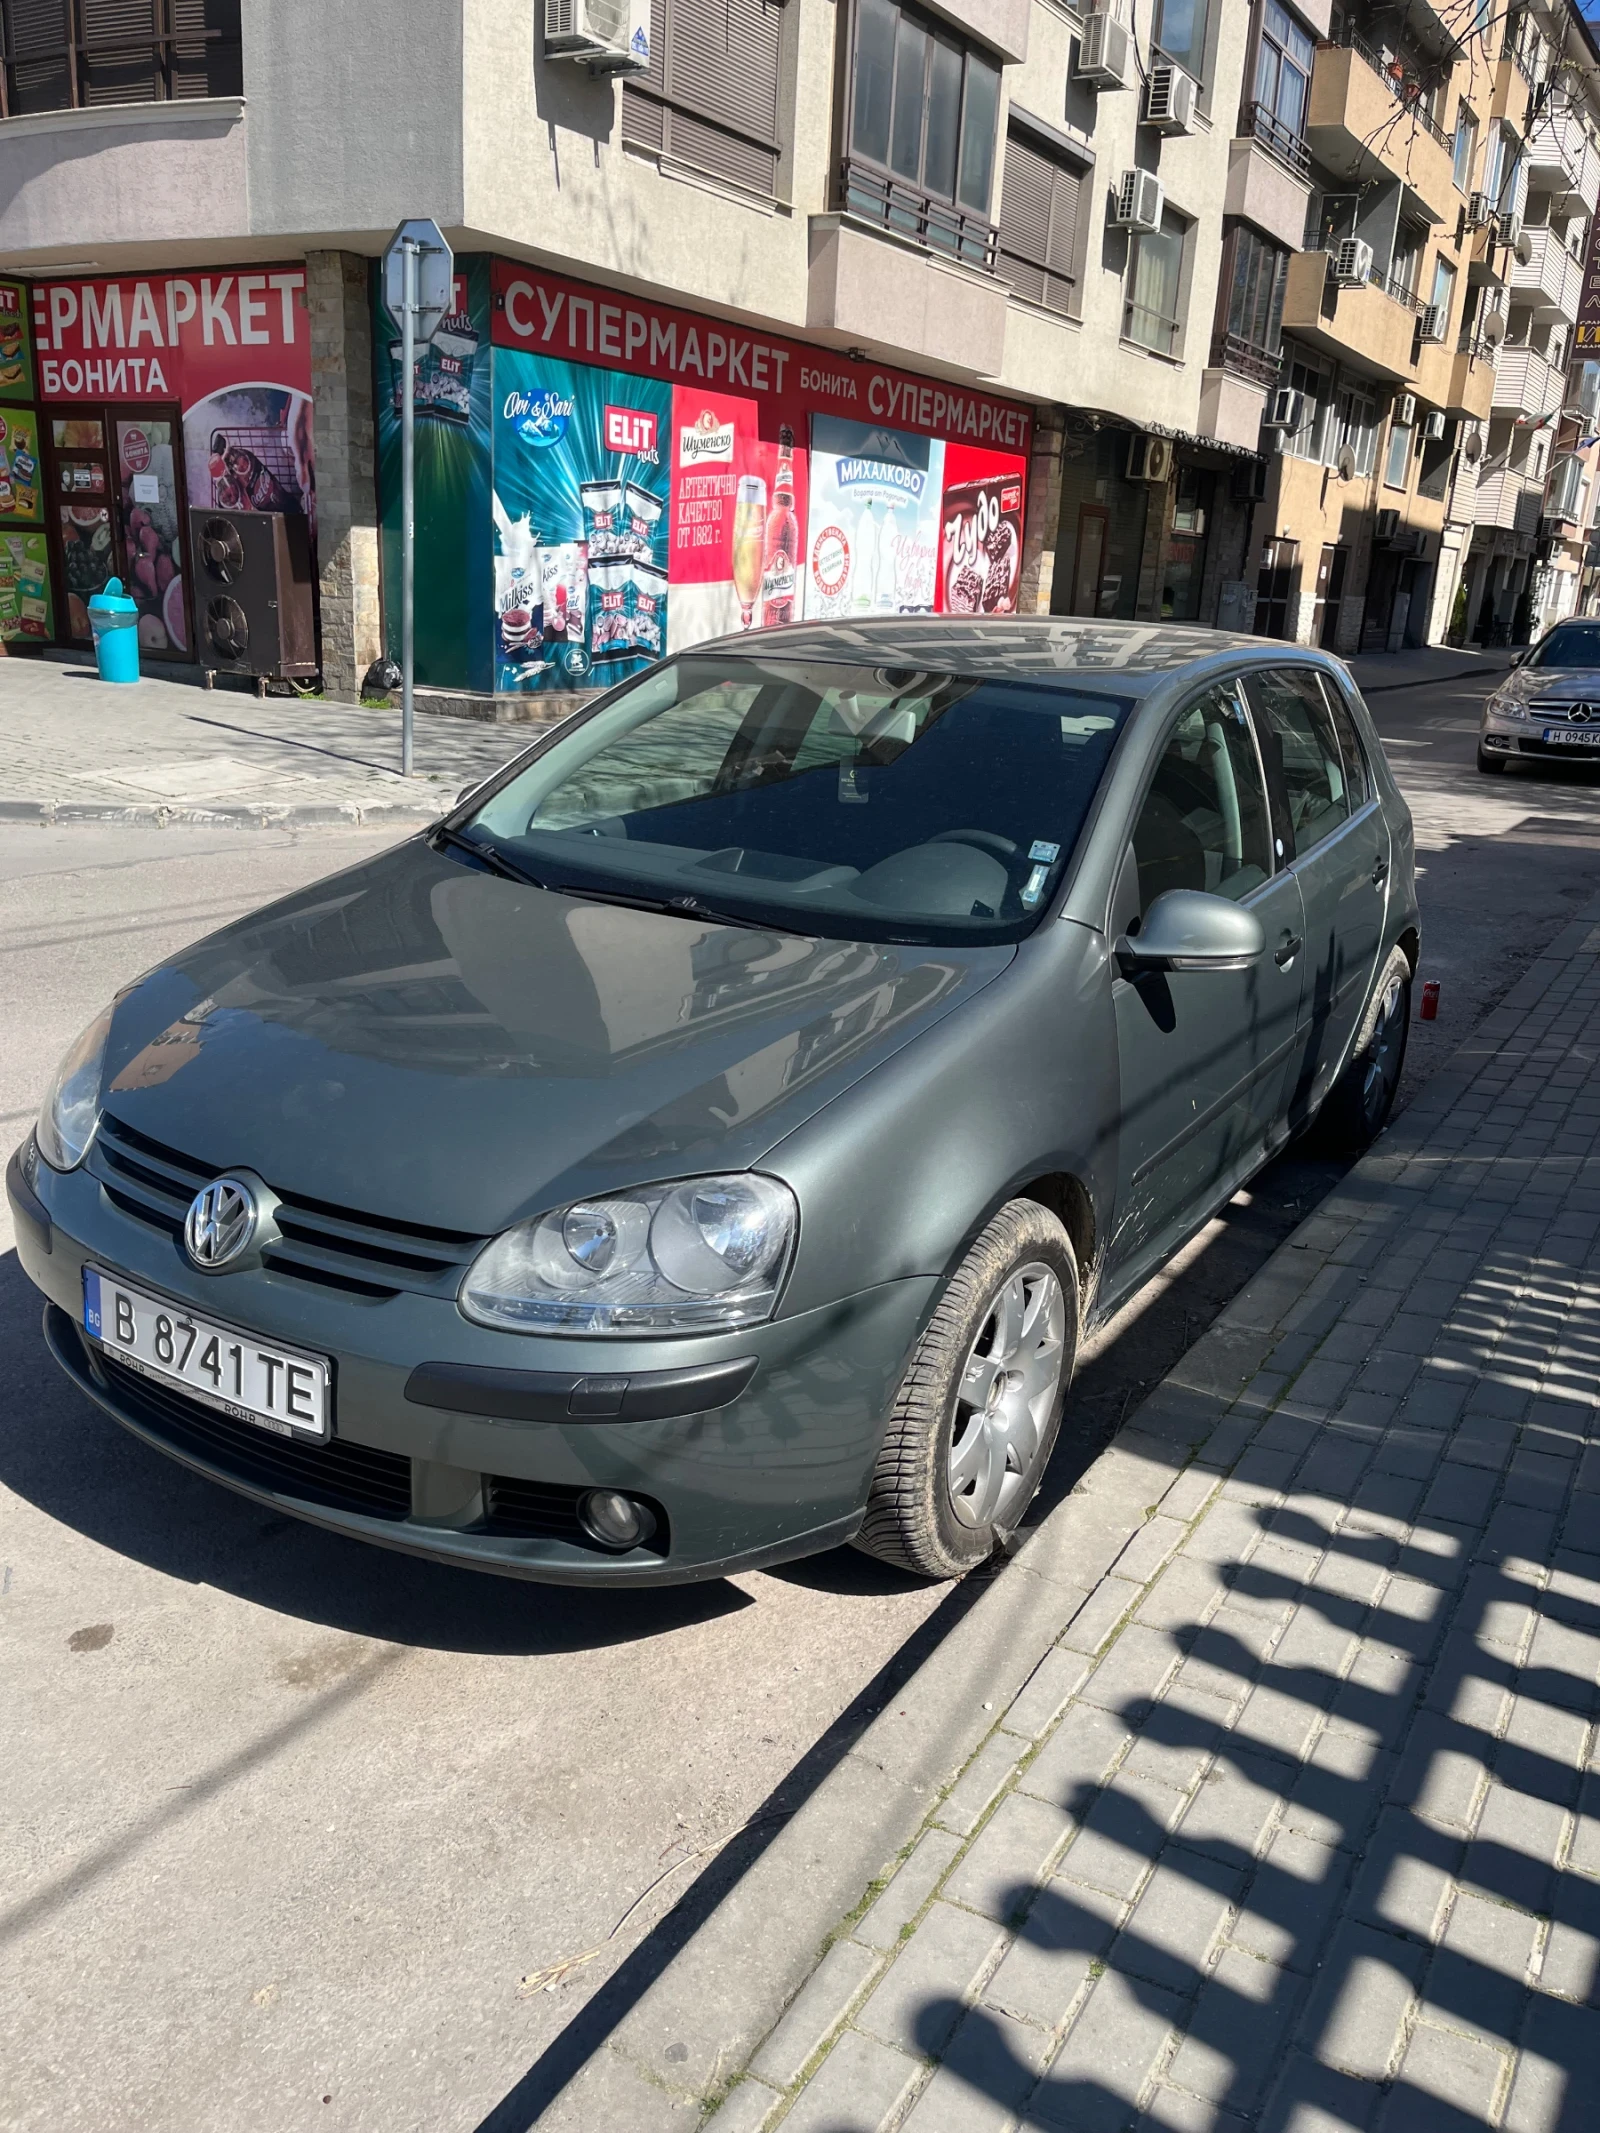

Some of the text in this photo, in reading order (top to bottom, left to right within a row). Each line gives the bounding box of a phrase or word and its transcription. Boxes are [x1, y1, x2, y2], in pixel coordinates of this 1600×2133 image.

[43, 357, 169, 393] БОНИТА
[505, 281, 789, 394] СУПЕРМАРКЕТ
[800, 367, 858, 400] БОНИТА
[868, 375, 1029, 447] СУПЕРМАРКЕТ
[637, 445, 660, 464] nuts
[682, 434, 731, 460] Шуменско
[679, 474, 737, 499] АВТЕНТИЧНО
[841, 461, 921, 493] МИХАЛКОВО
[677, 499, 722, 525] КАЧЕСТВО
[677, 527, 690, 548] ОТ
[691, 524, 713, 546] 1882
[944, 490, 999, 566] Чудо
[500, 582, 533, 613] Milkiss
[1553, 731, 1600, 744] H 0945 K
[88, 1308, 101, 1327] BG
[115, 1292, 315, 1423] B 8741 TE
